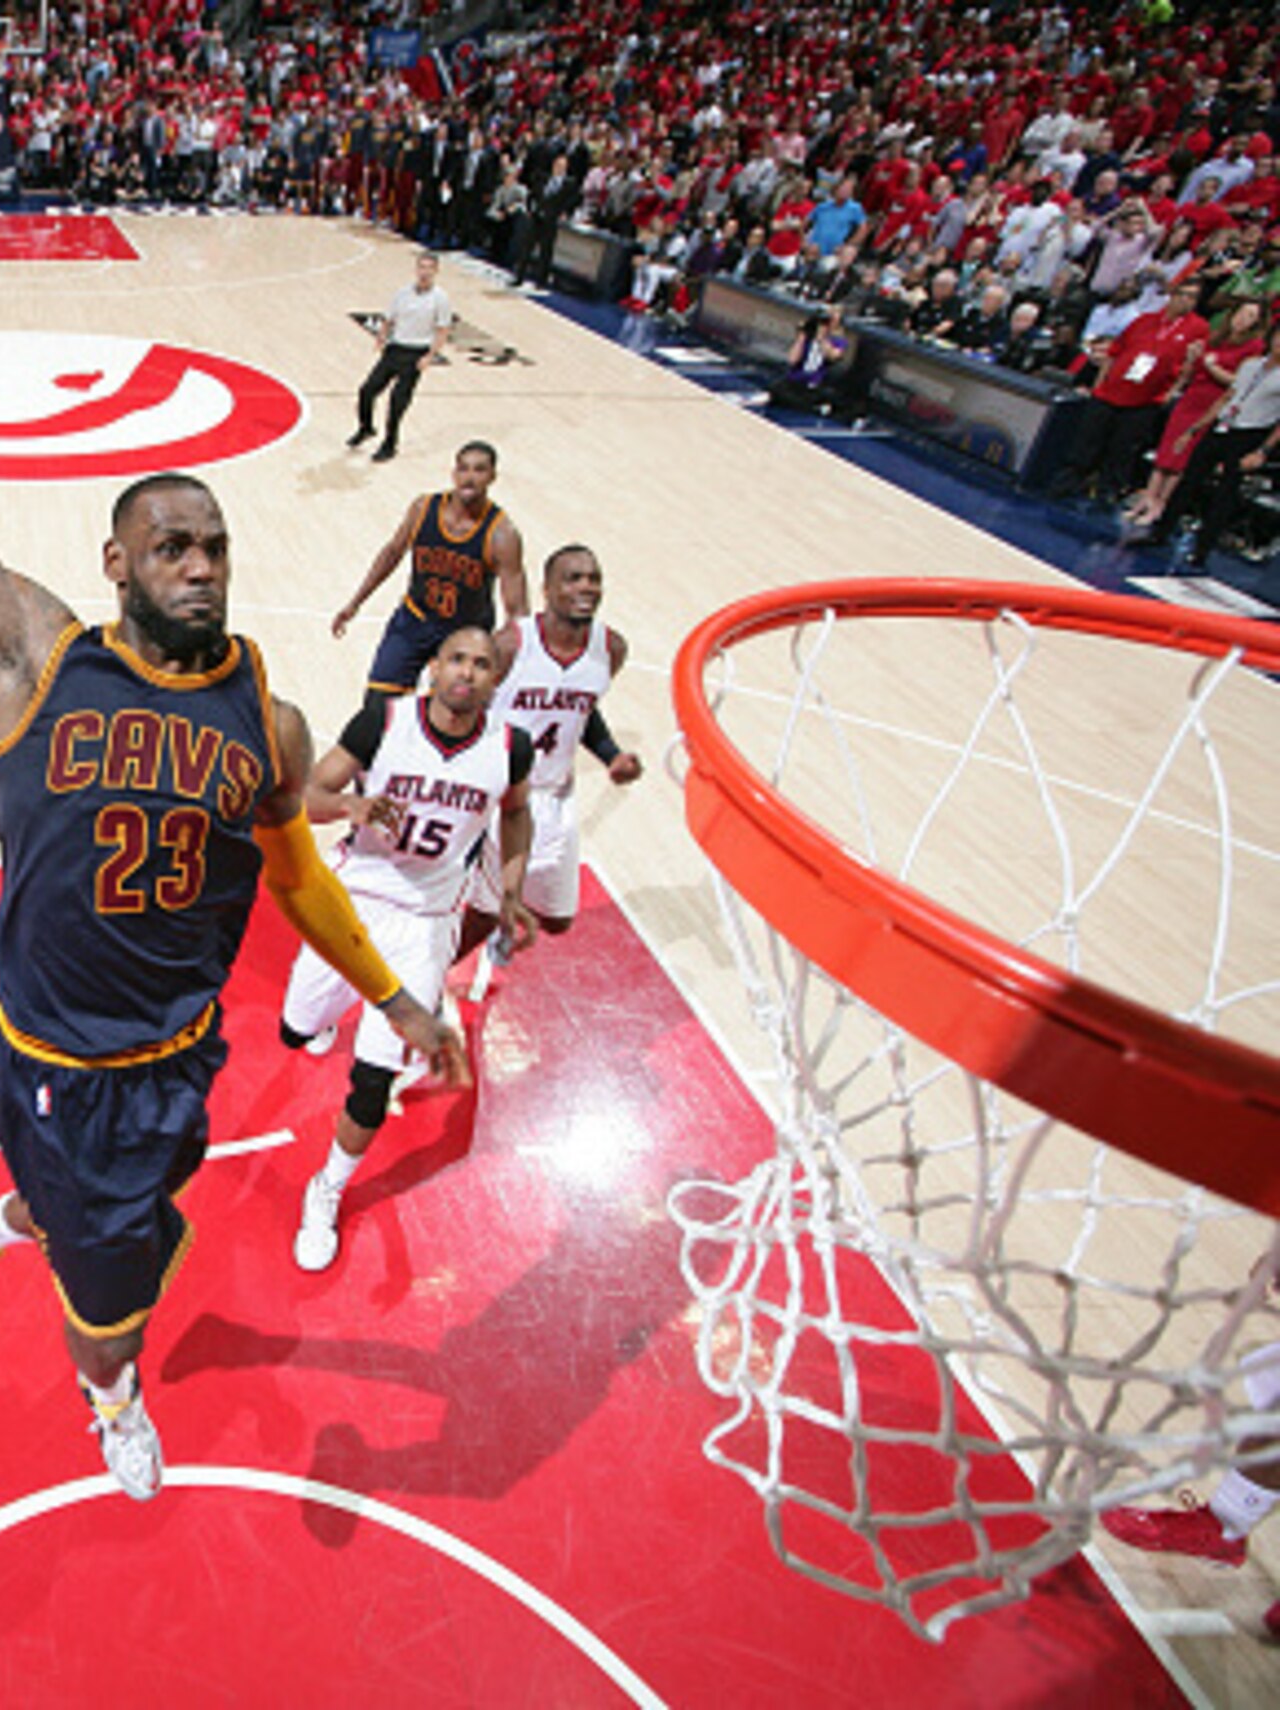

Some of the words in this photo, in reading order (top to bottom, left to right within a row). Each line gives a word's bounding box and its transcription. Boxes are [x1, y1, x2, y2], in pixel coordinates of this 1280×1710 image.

[512, 686, 599, 716] ATLANTA
[532, 722, 561, 756] 4
[46, 709, 262, 820] CAVS
[384, 773, 489, 816] ATLANTA
[95, 803, 209, 913] 23
[393, 812, 454, 860] 15
